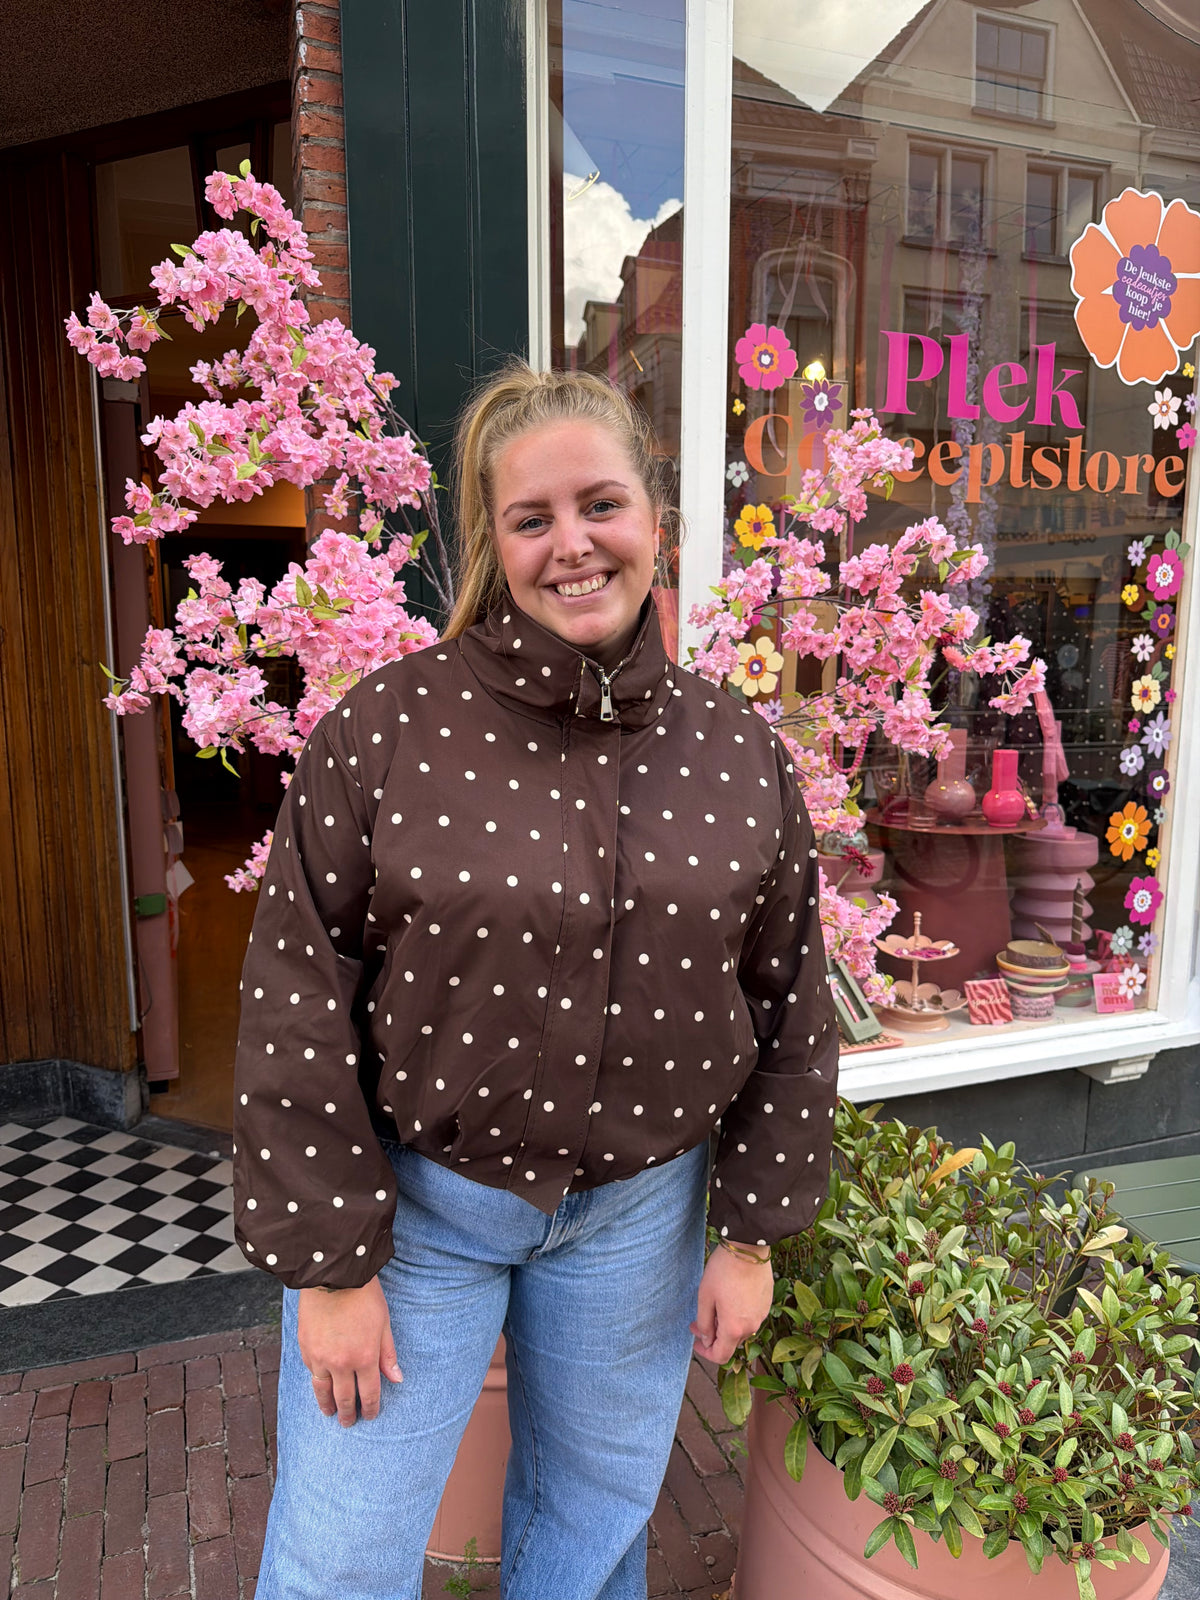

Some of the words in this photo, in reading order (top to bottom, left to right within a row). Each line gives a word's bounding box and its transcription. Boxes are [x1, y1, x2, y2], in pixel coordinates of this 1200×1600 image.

[1121, 275, 1168, 304] cadeautjes
[1124, 260, 1138, 275] De
[1139, 266, 1171, 291] leukste
[1126, 284, 1148, 307] koop
[1152, 299, 1163, 312] je
[1128, 301, 1151, 321] hier!
[877, 330, 1085, 429] Plek
[744, 414, 1186, 504] Coceptstore
